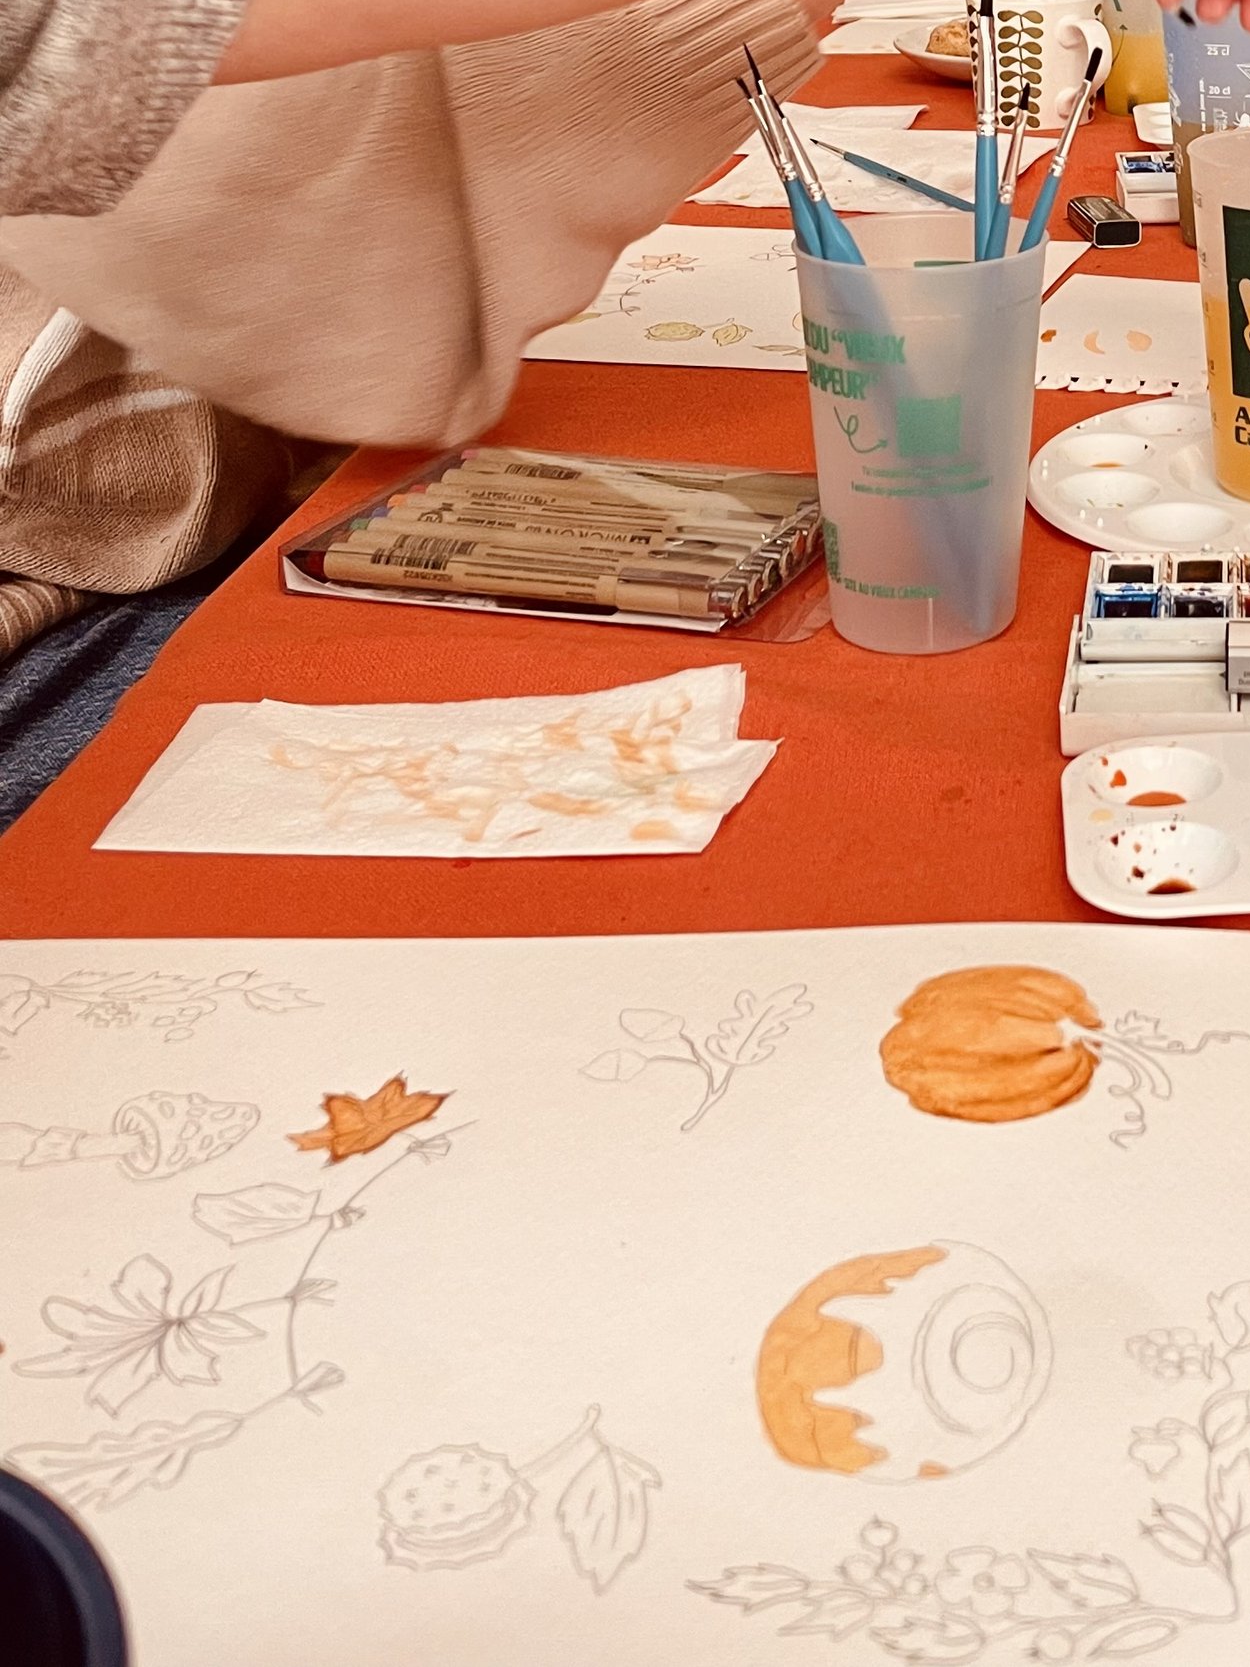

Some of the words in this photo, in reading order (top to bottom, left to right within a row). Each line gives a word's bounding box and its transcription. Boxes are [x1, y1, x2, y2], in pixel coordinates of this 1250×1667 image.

[1207, 46, 1219, 56] 25
[1209, 85, 1220, 95] 20
[1222, 85, 1231, 95] cl
